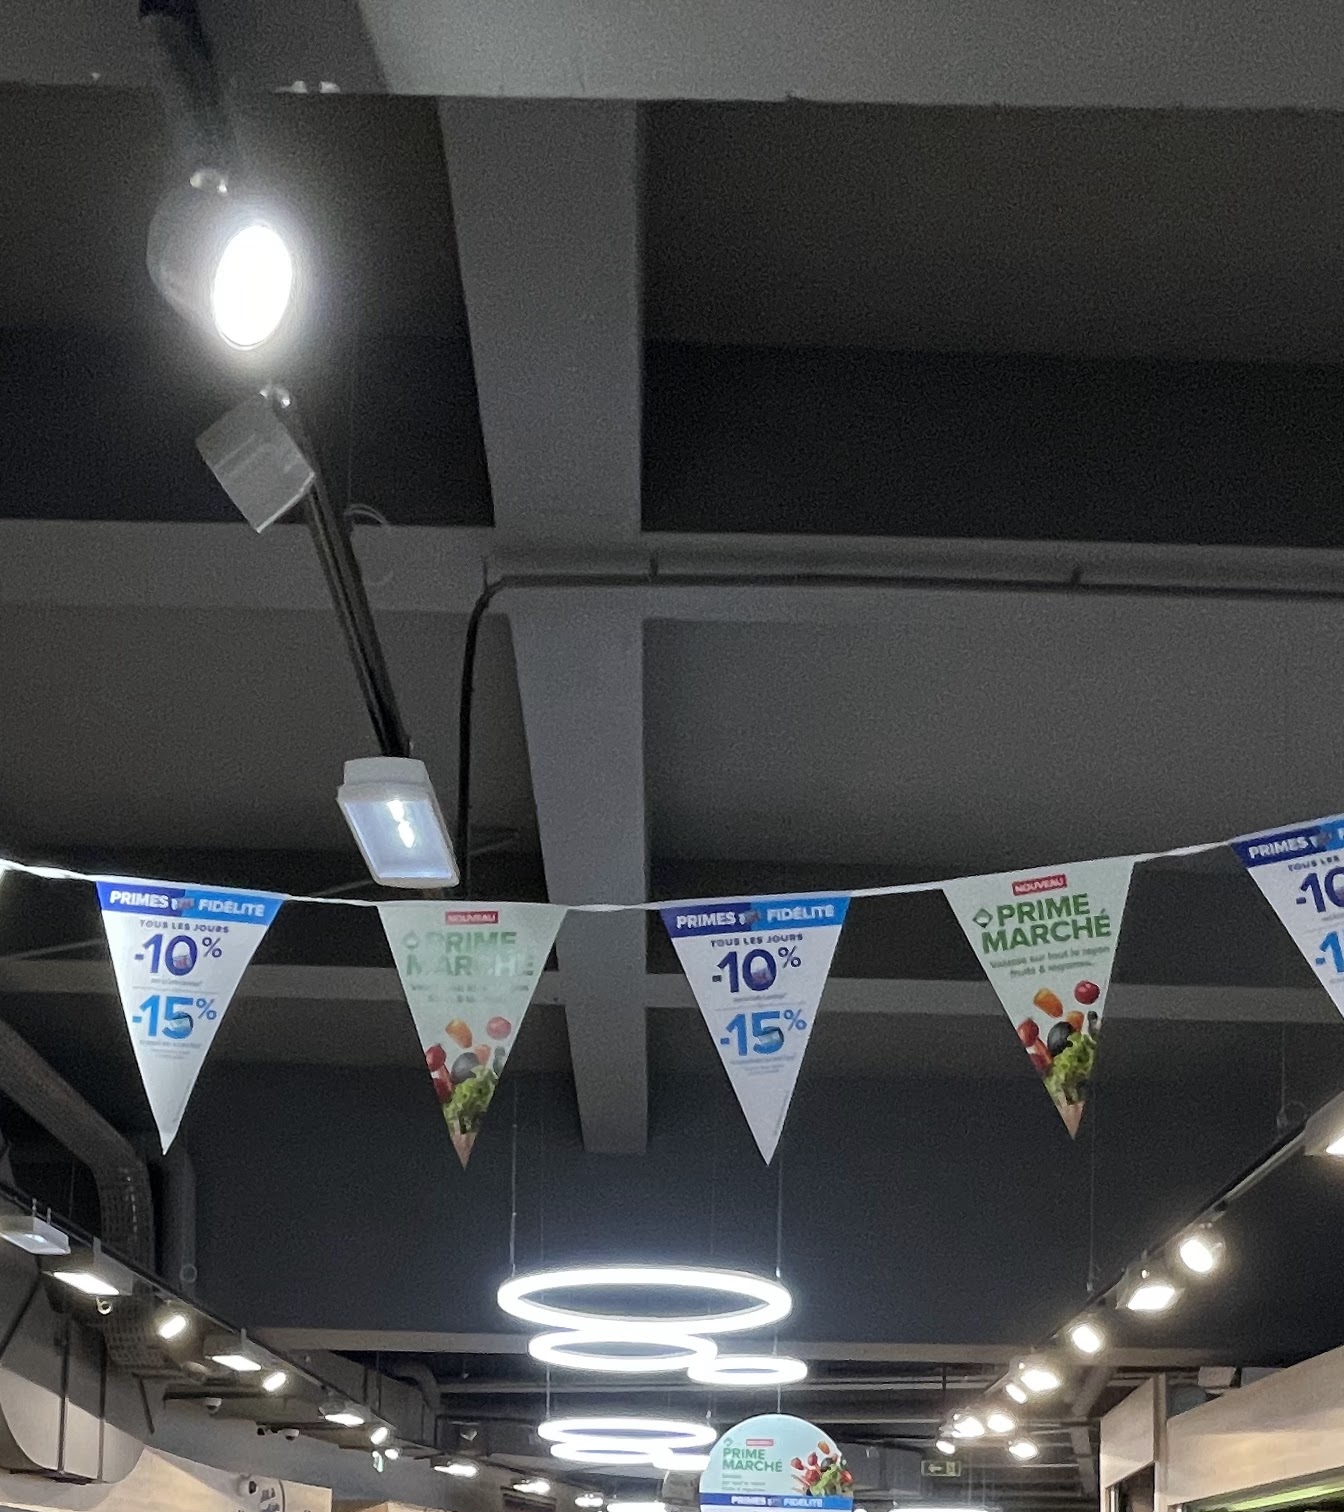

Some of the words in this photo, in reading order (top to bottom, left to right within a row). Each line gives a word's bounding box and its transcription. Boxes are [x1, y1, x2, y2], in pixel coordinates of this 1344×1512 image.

[1248, 837, 1309, 859] PRIMES
[1013, 876, 1065, 894] NOUVEAU
[109, 890, 169, 910] PRIMES
[198, 898, 265, 917] FIDÉLITÉ
[676, 911, 736, 929] PRIMES
[767, 904, 835, 923] FIDÉLITÉ
[996, 893, 1091, 927] PRIME
[710, 937, 740, 948] TOUS
[743, 935, 763, 945] LES
[766, 933, 803, 944] JOURS
[981, 908, 1112, 954] MARCHÉ
[134, 933, 222, 976] -10%
[712, 946, 802, 994] -10%
[132, 994, 217, 1039] -15%
[720, 1008, 807, 1056] -15%
[722, 1447, 766, 1460] PRIME
[722, 1459, 783, 1472] MARCHÉ
